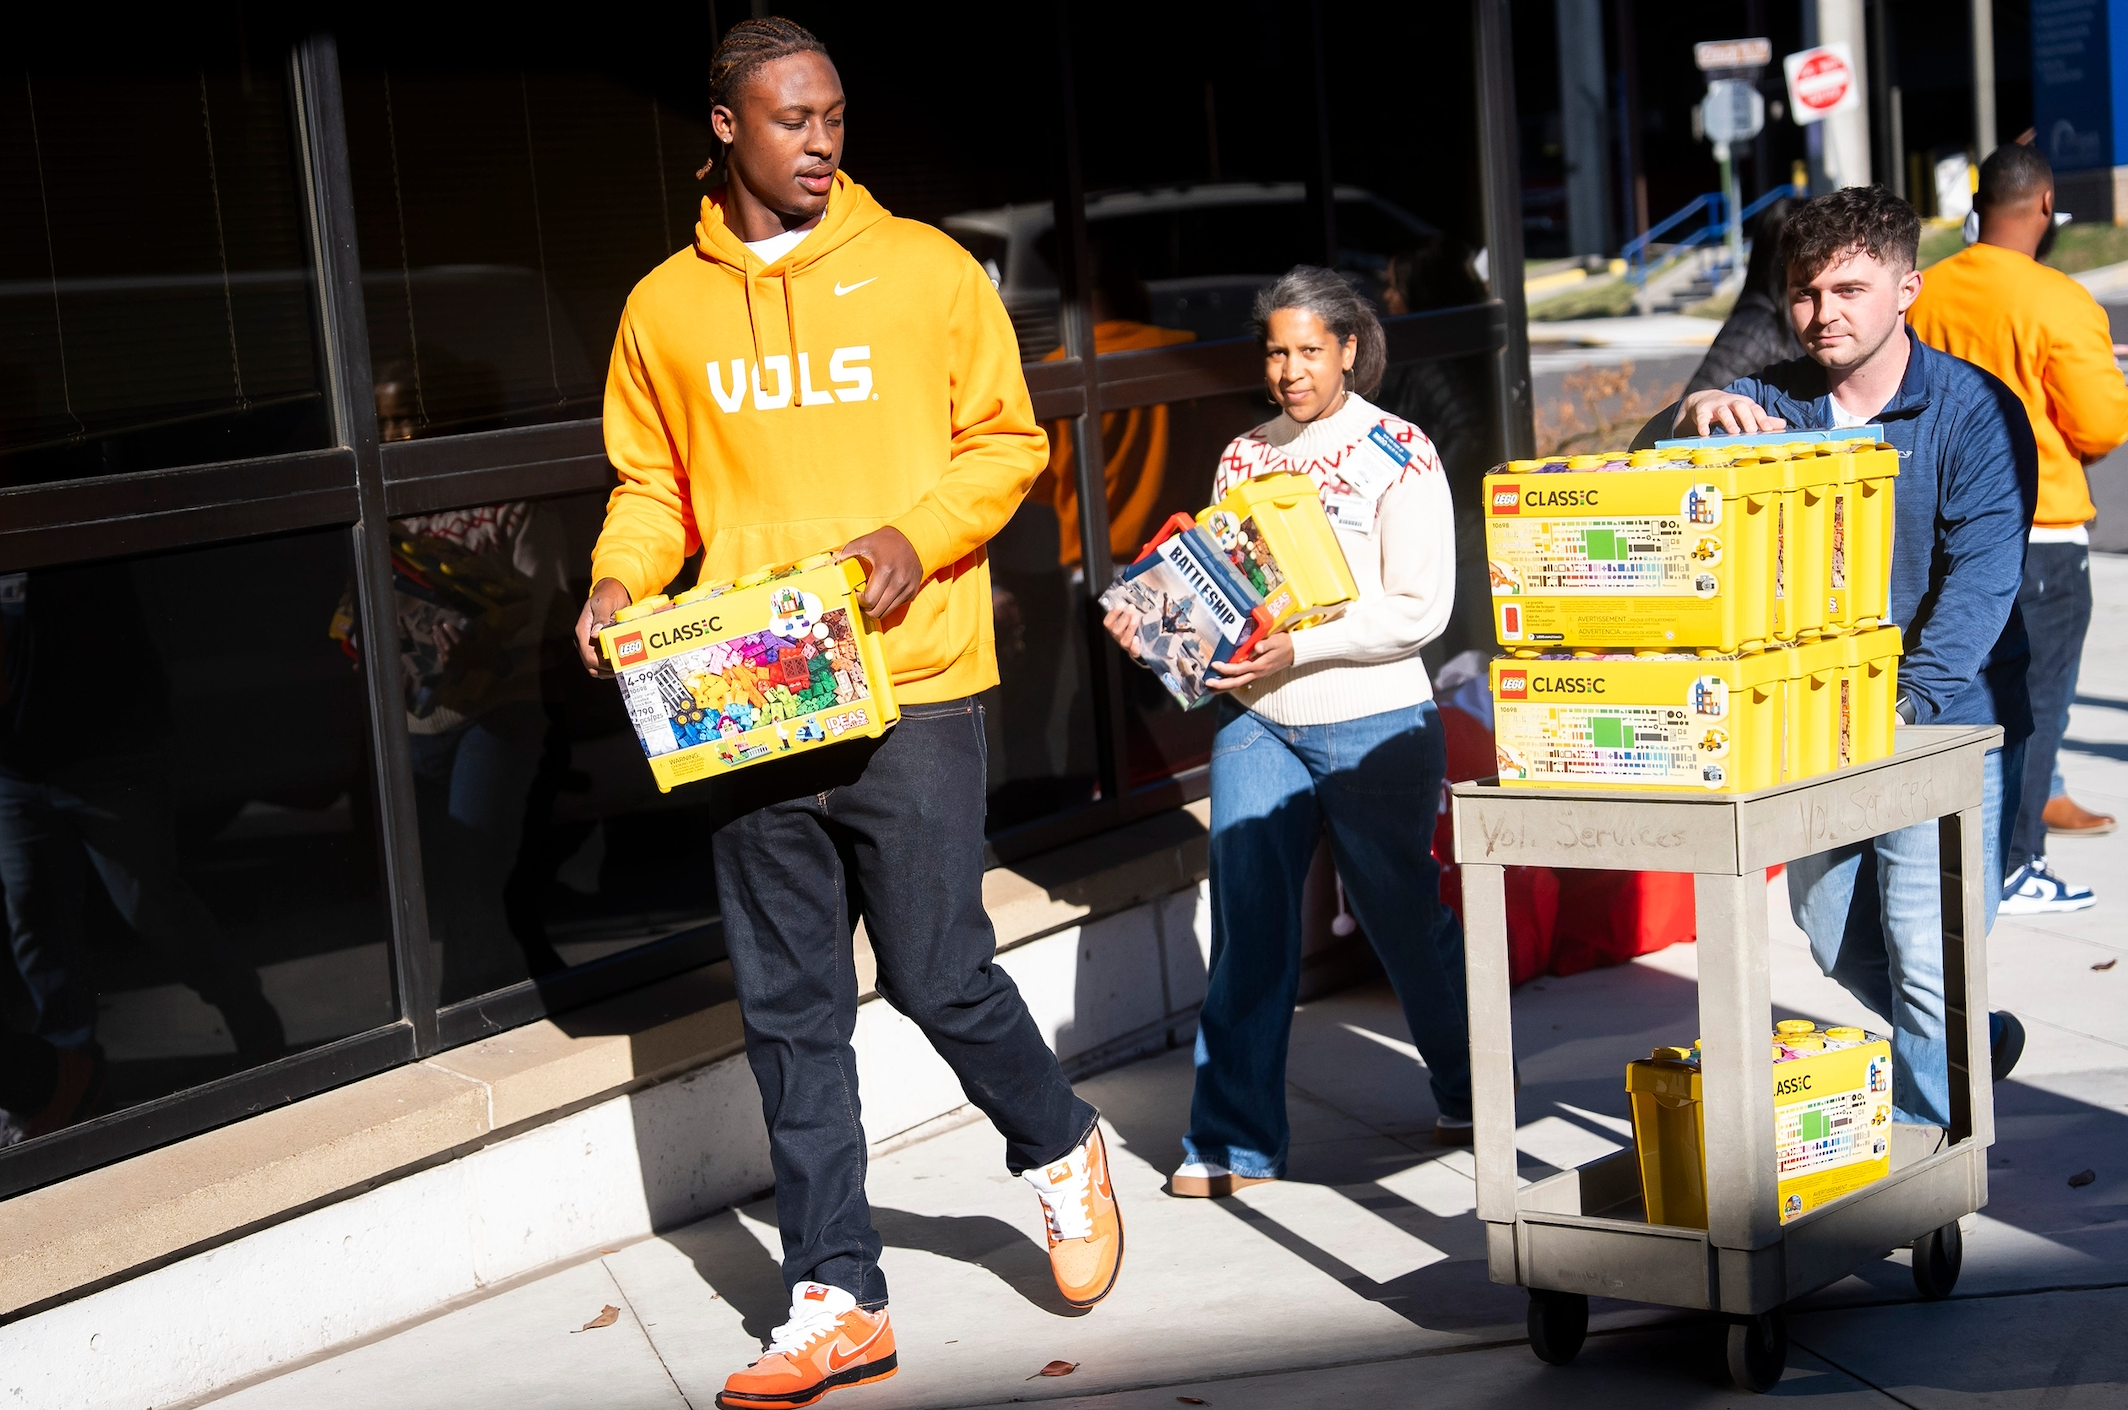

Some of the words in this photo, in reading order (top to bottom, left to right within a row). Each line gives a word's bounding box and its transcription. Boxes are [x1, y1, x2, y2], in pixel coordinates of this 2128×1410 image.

[706, 345, 873, 414] VOLS
[1494, 493, 1518, 506] LEGO
[1525, 490, 1599, 507] CLASSIC
[1169, 546, 1236, 626] BATTLESHIP
[1267, 591, 1290, 614] IDEAS
[619, 641, 642, 657] LEGO
[649, 616, 723, 649] CLASSIC
[628, 671, 654, 687] 4-99
[630, 686, 648, 694] 10698
[1502, 679, 1525, 690] LEGO
[1532, 677, 1606, 694] CLASSIC
[637, 706, 655, 717] 790
[640, 714, 664, 725] pcs/pzs
[825, 708, 867, 730] IDEAS
[1479, 807, 1537, 857] Vol.
[1557, 818, 1686, 848] Services
[1773, 1075, 1813, 1097] ASSIC
